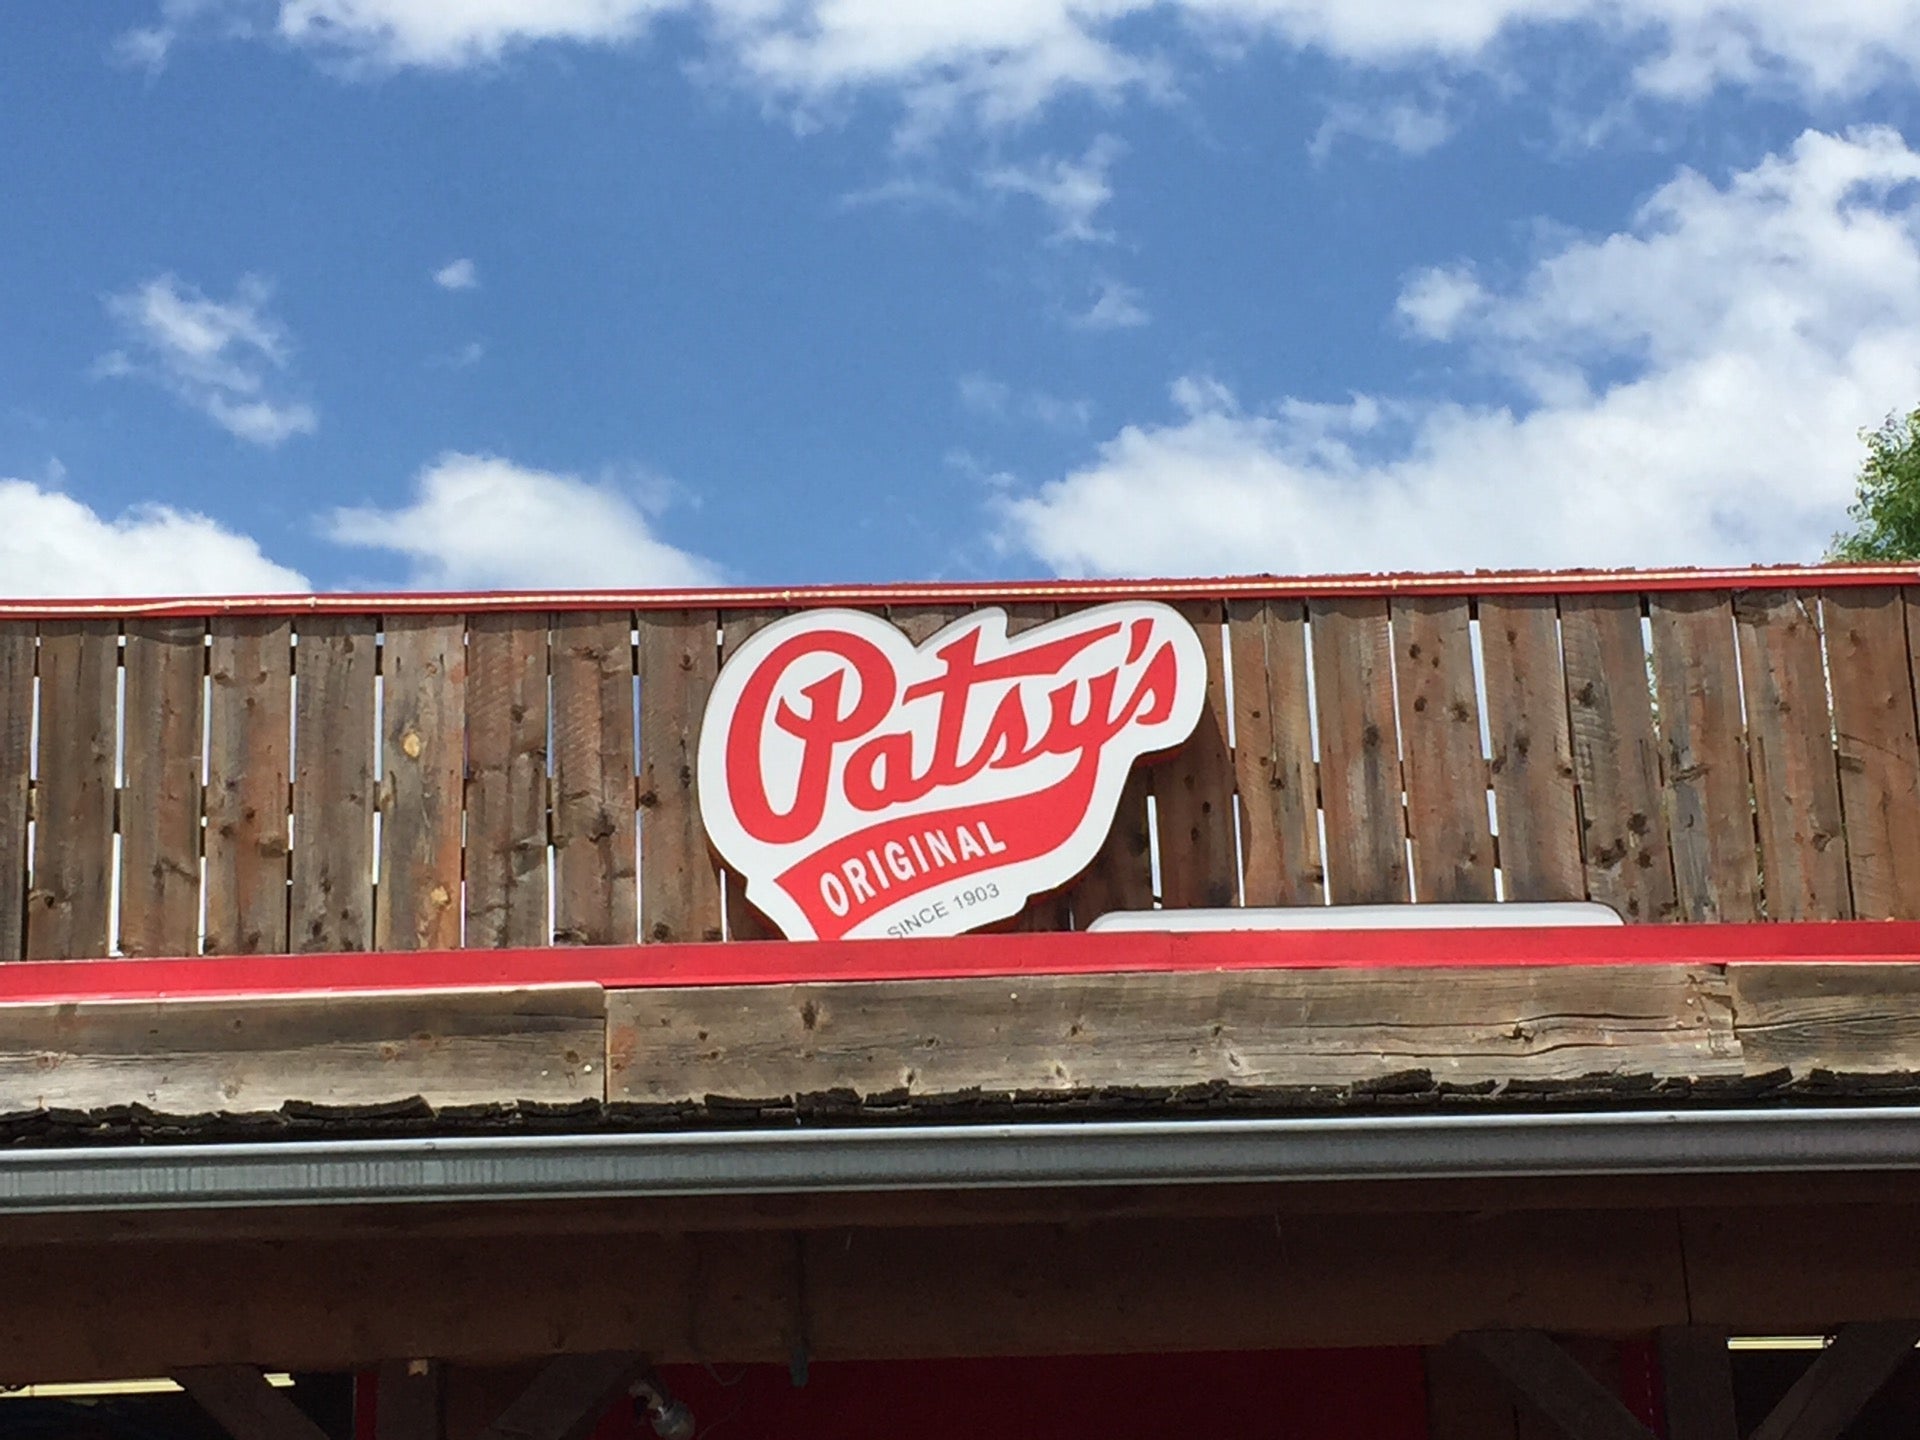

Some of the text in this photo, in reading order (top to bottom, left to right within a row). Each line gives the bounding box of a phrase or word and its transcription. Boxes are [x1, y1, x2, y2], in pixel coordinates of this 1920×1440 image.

[726, 618, 1178, 844] Patsy's
[819, 821, 1007, 918] ORIGINAL
[887, 883, 1000, 938] SINCE 1903
